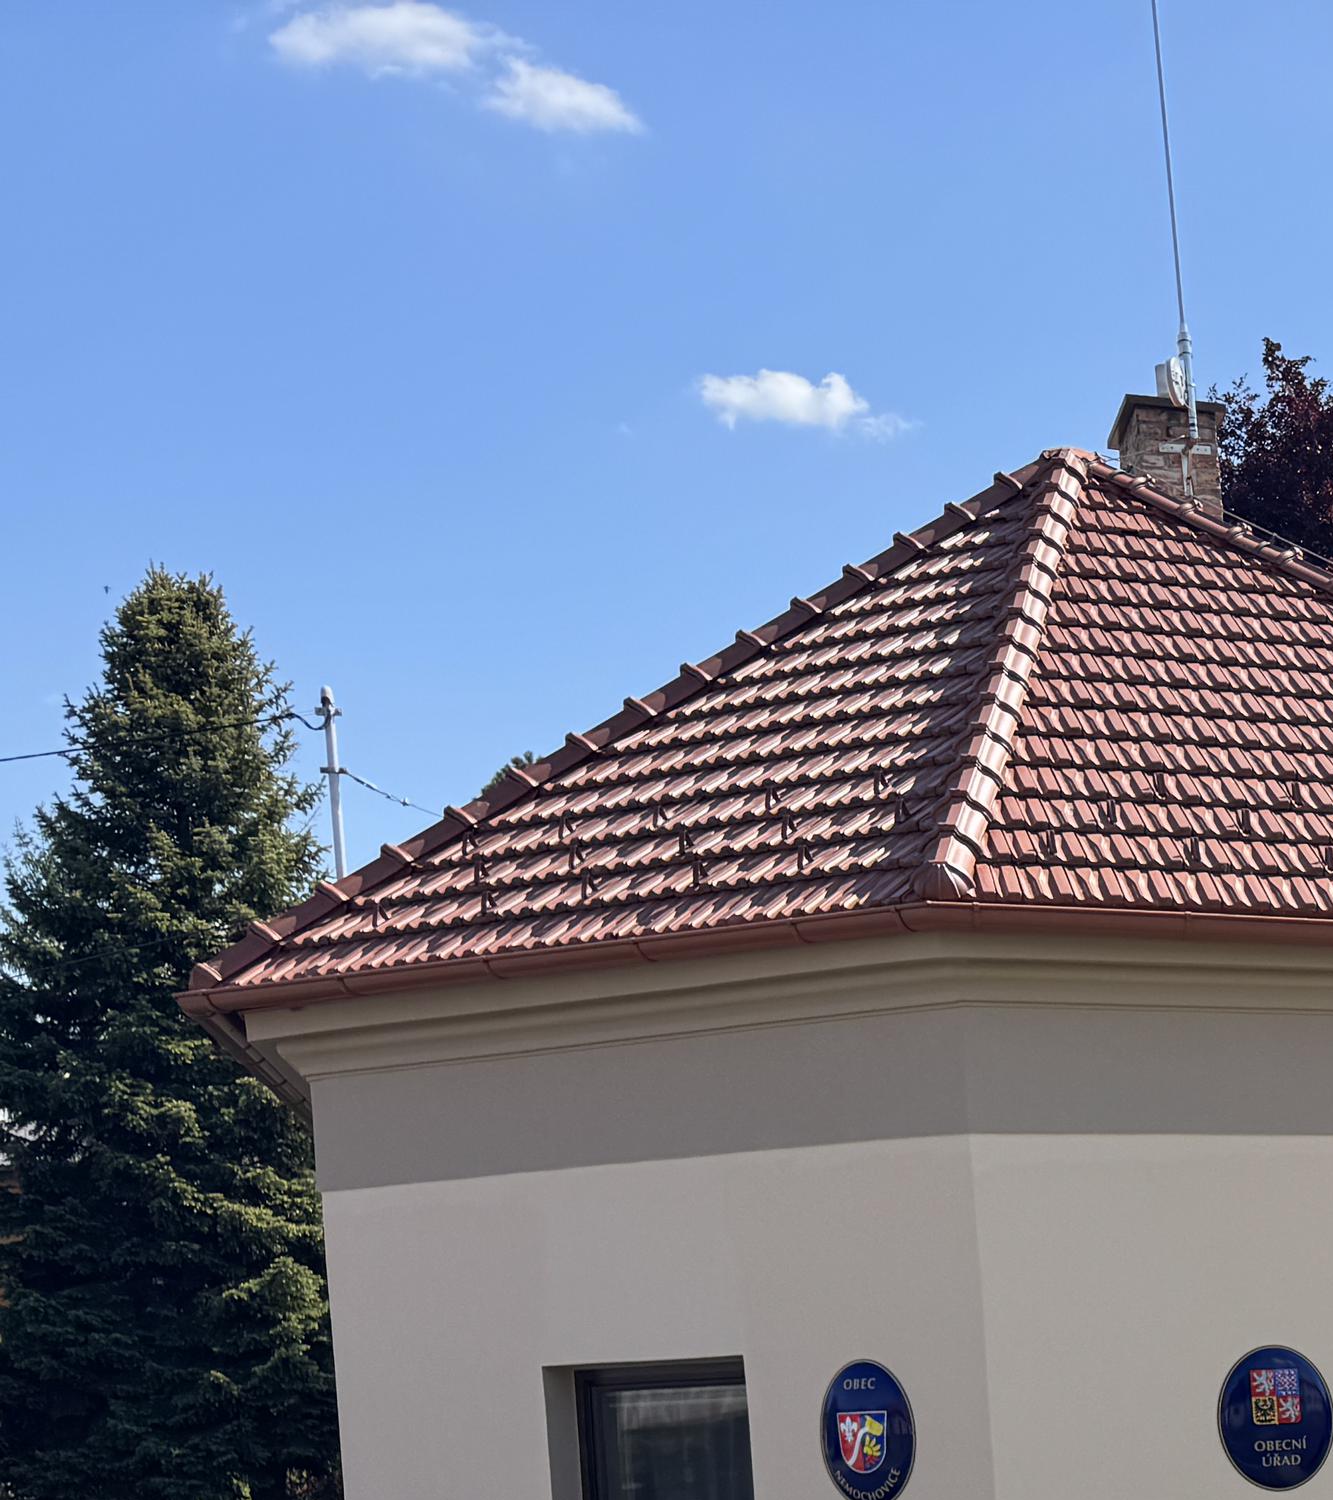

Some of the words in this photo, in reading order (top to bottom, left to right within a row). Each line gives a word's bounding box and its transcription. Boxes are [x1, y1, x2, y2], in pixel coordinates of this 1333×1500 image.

[843, 1377, 876, 1390] OBEC
[1254, 1435, 1307, 1452] OBECNÍ
[1262, 1452, 1301, 1467] ÚŘAD
